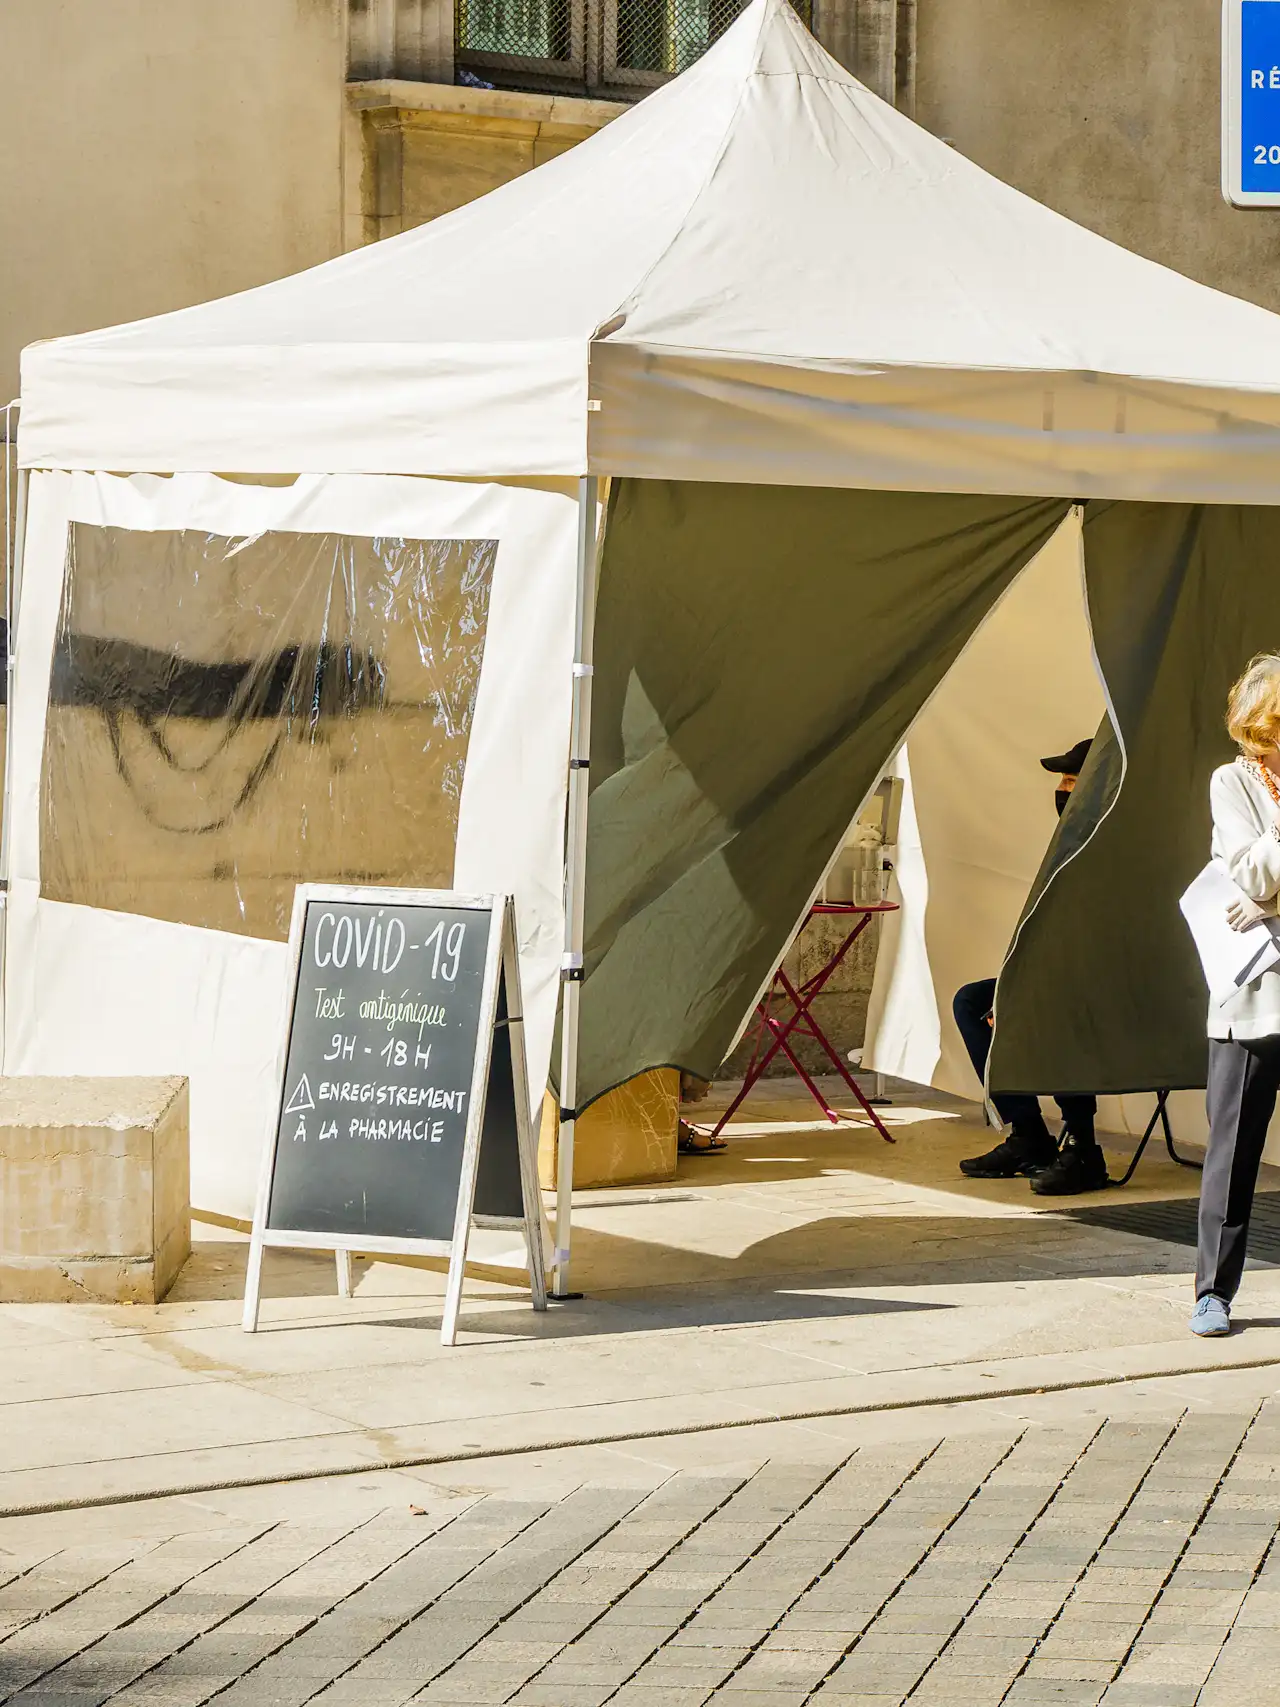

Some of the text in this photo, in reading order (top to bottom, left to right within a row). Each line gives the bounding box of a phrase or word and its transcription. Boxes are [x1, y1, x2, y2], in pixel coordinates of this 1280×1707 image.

[314, 988, 447, 1041] Test antigénique
[324, 1034, 357, 1061] 9H
[293, 1115, 306, 1142] À
[319, 1120, 338, 1139] LA
